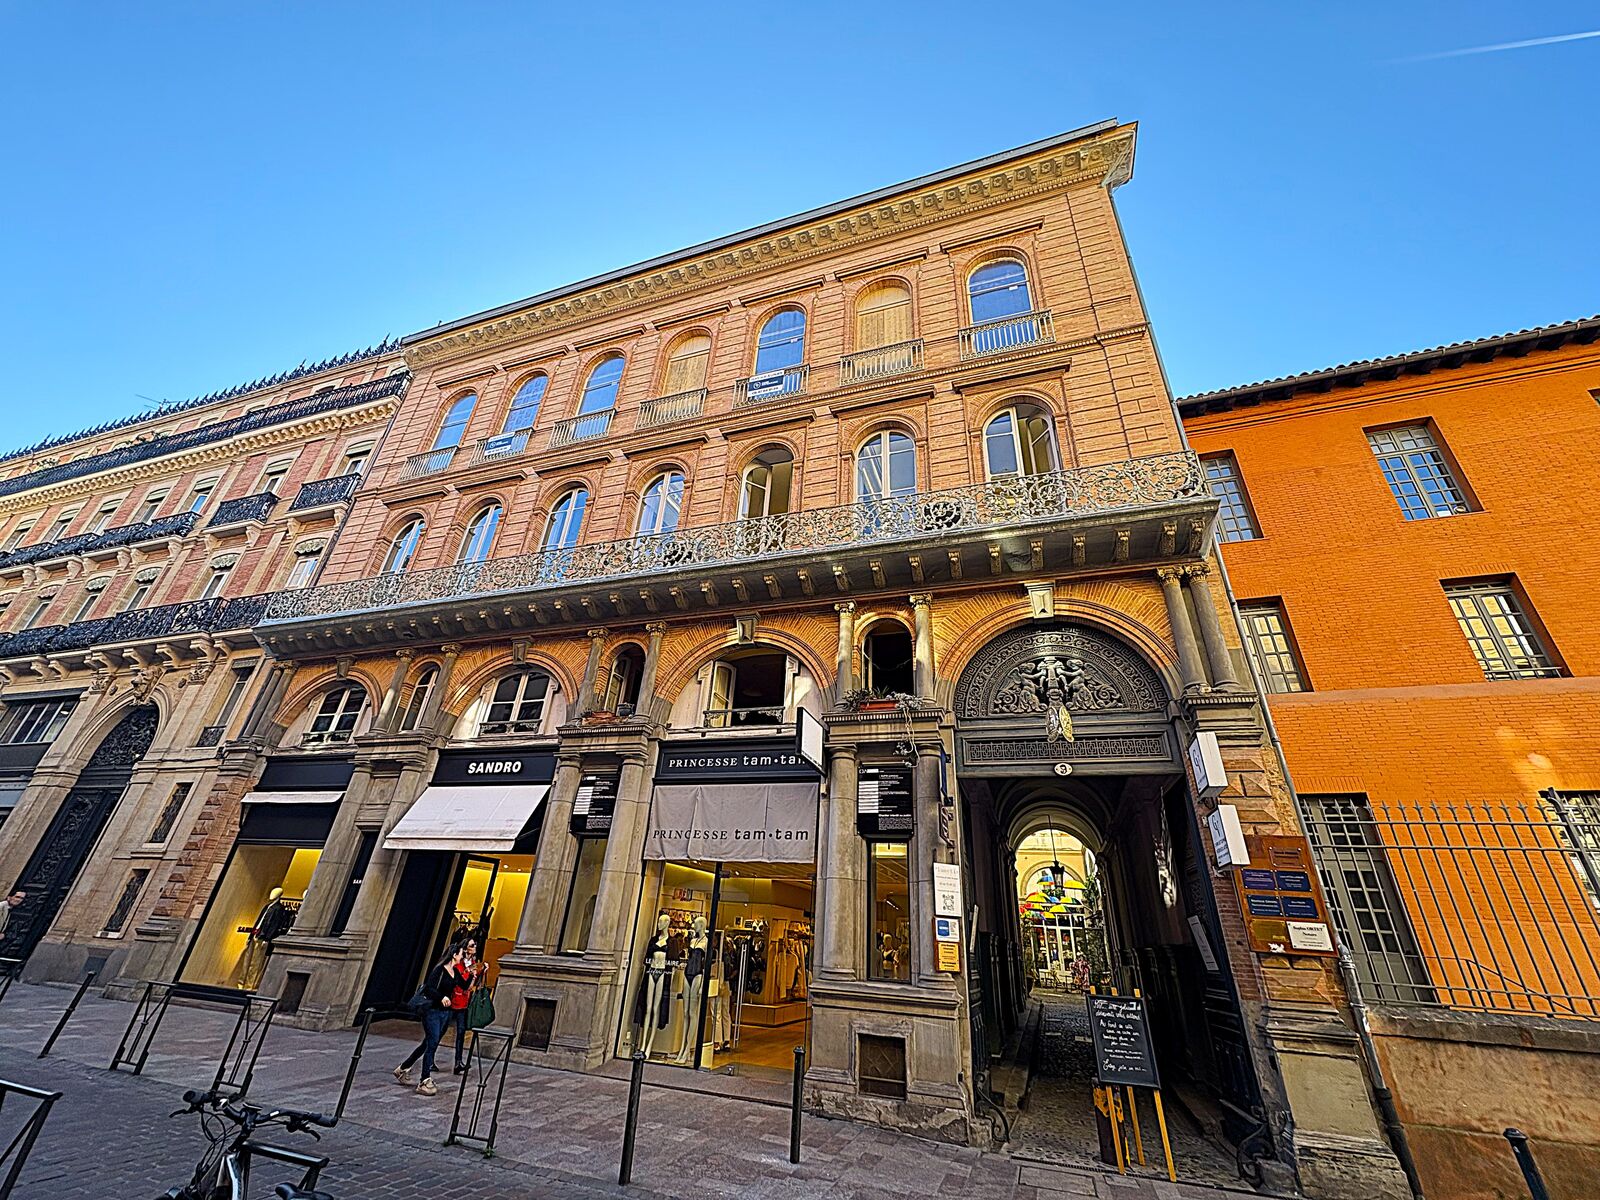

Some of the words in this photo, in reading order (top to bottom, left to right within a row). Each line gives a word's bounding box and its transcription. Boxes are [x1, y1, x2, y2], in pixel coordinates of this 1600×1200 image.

[467, 761, 522, 774] SANDRO
[668, 757, 738, 768] PRINCESSE
[1060, 764, 1068, 775] 9
[653, 829, 728, 840] PRINCESSE
